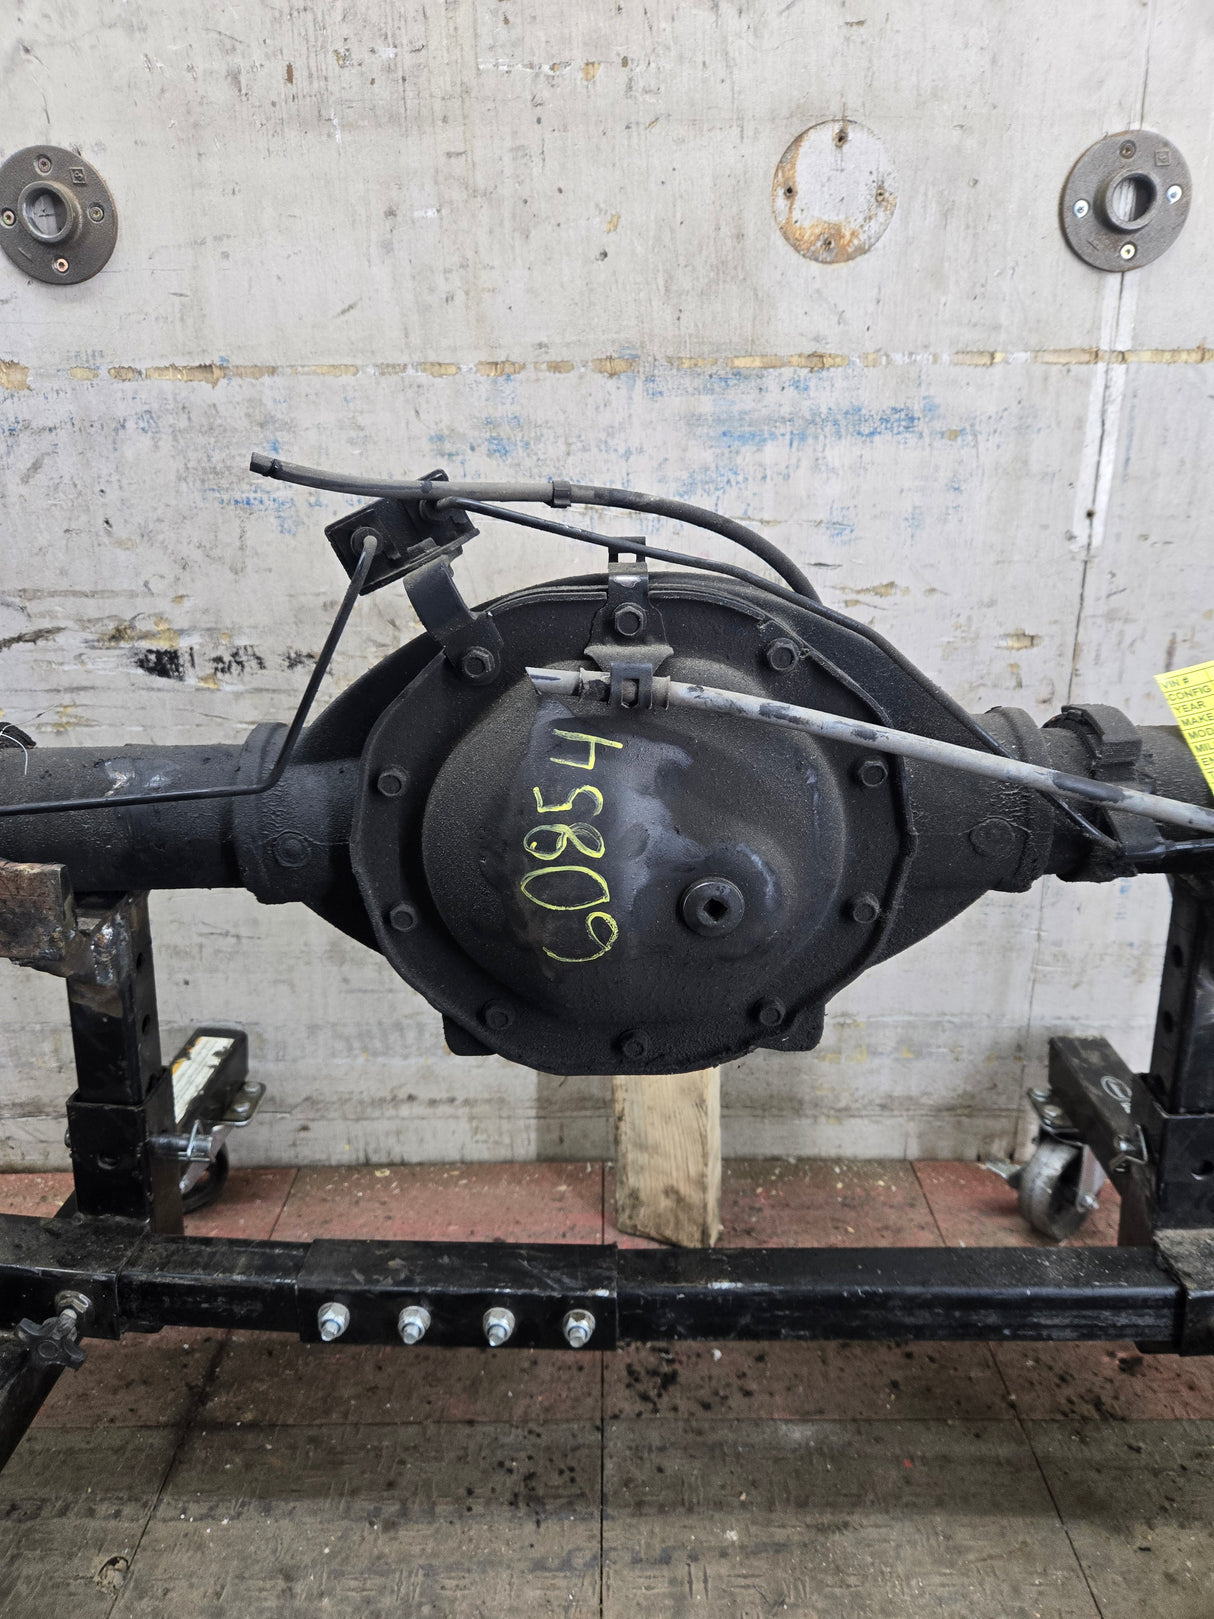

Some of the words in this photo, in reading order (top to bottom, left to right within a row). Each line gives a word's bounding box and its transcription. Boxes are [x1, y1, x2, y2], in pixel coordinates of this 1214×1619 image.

[1161, 679, 1180, 689] VIN
[1168, 684, 1212, 702] CONFIG
[1173, 700, 1207, 714] YEAR
[1181, 712, 1214, 726] MAKE
[520, 728, 624, 963] 60854
